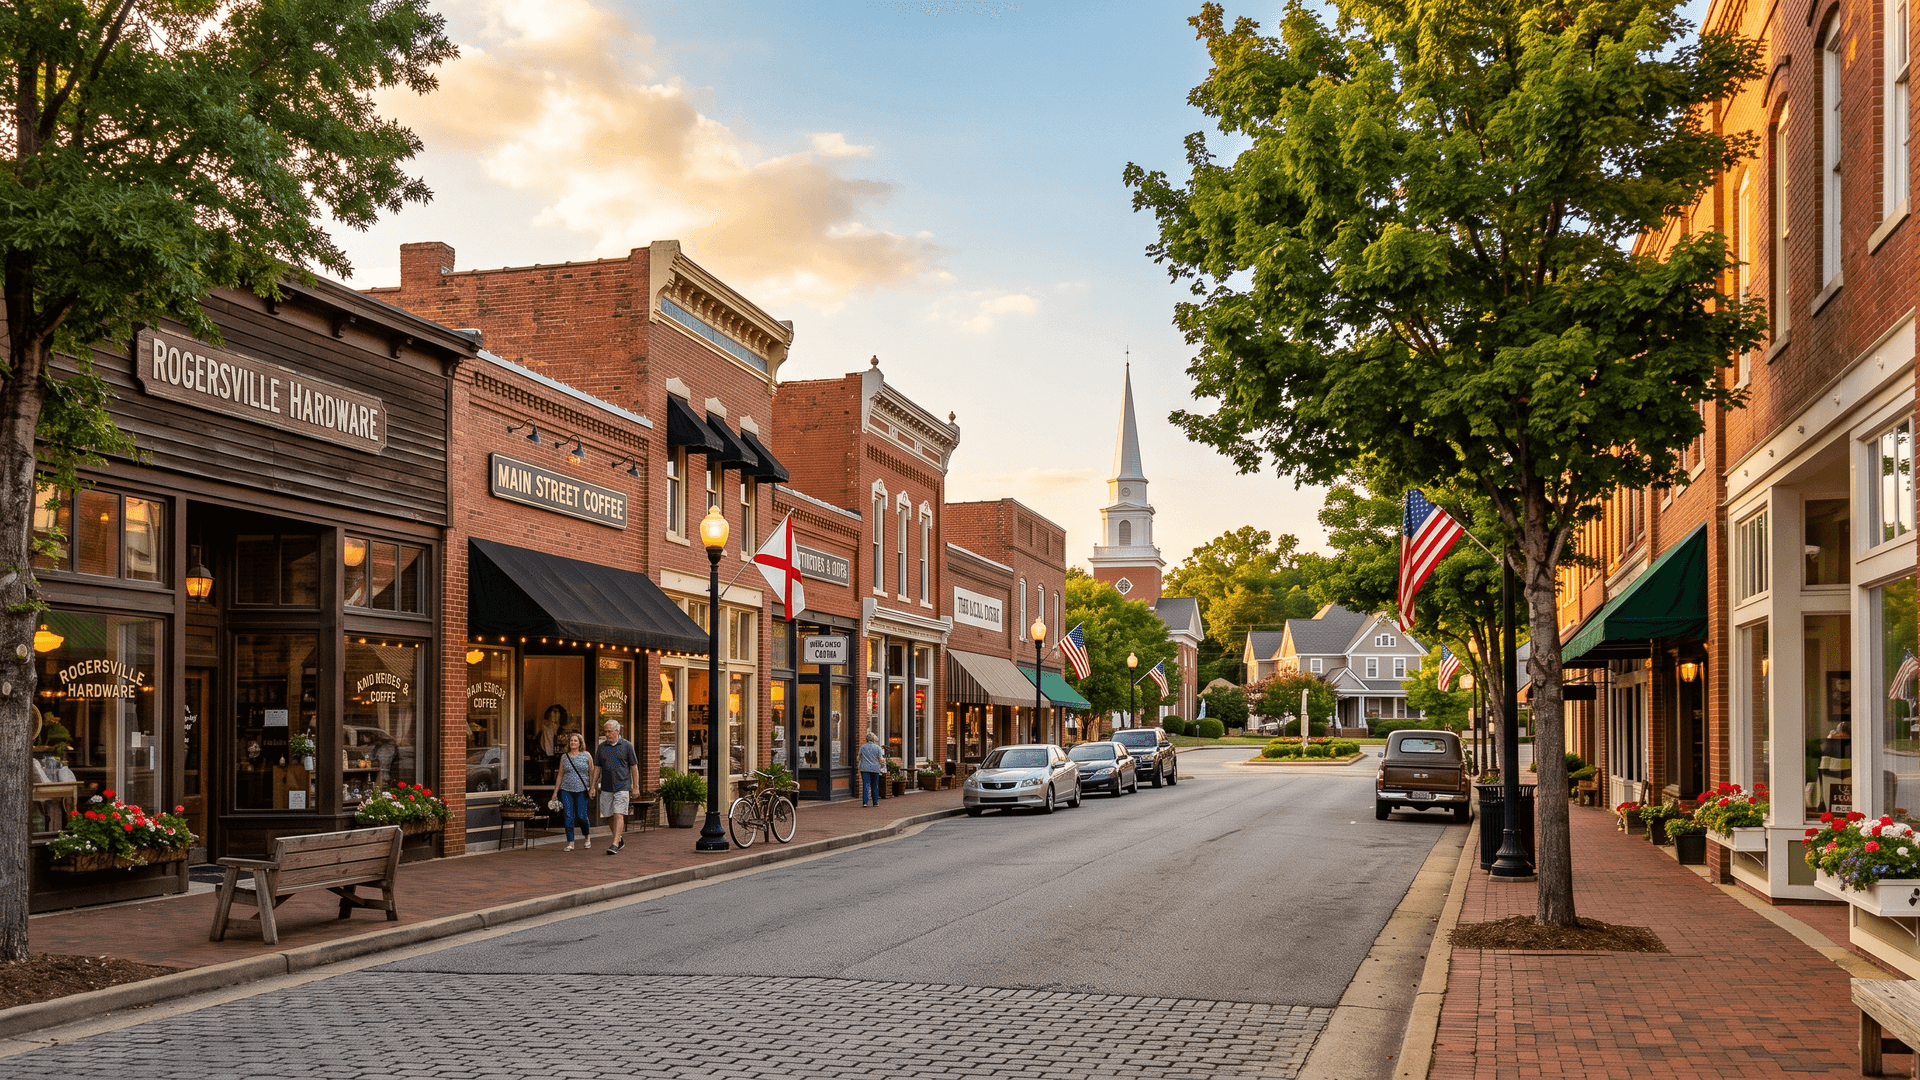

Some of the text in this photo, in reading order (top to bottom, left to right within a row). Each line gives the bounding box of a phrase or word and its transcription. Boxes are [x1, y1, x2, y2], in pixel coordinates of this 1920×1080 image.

[152, 337, 379, 441] ROGERSVILLE HARDWARE
[498, 463, 624, 520] MAIN STREET COFFEE
[59, 659, 145, 686] ROGERSVILLE
[68, 683, 135, 698] HARDWARE
